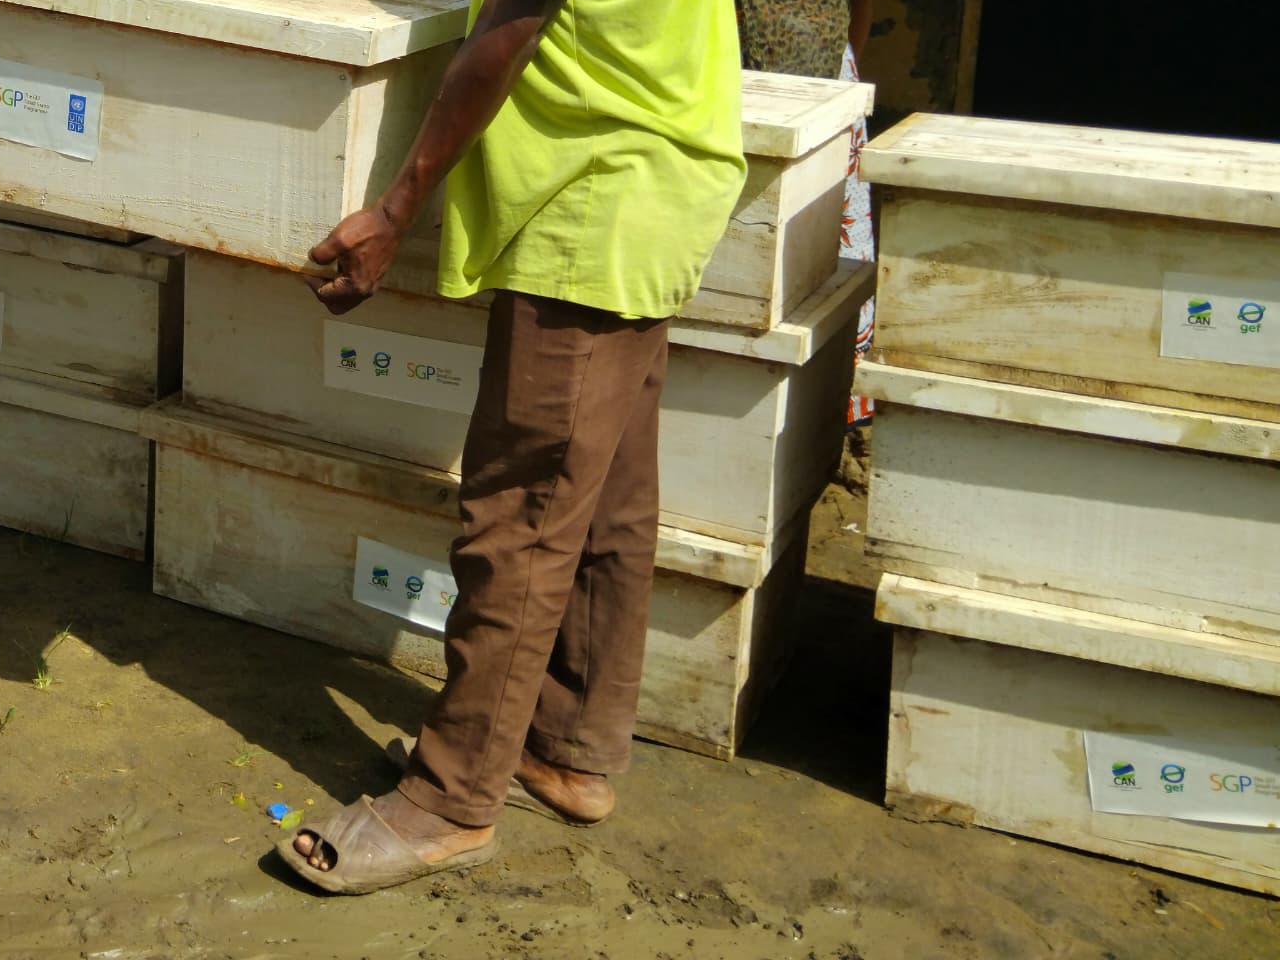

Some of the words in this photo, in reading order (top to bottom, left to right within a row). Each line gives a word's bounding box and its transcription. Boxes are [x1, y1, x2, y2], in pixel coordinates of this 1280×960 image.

[1188, 315, 1211, 326] CAN
[1240, 324, 1262, 334] gef
[406, 361, 435, 381] SGP
[1113, 777, 1136, 787] CAN
[1209, 773, 1253, 793] SGP
[1164, 784, 1185, 793] gef
